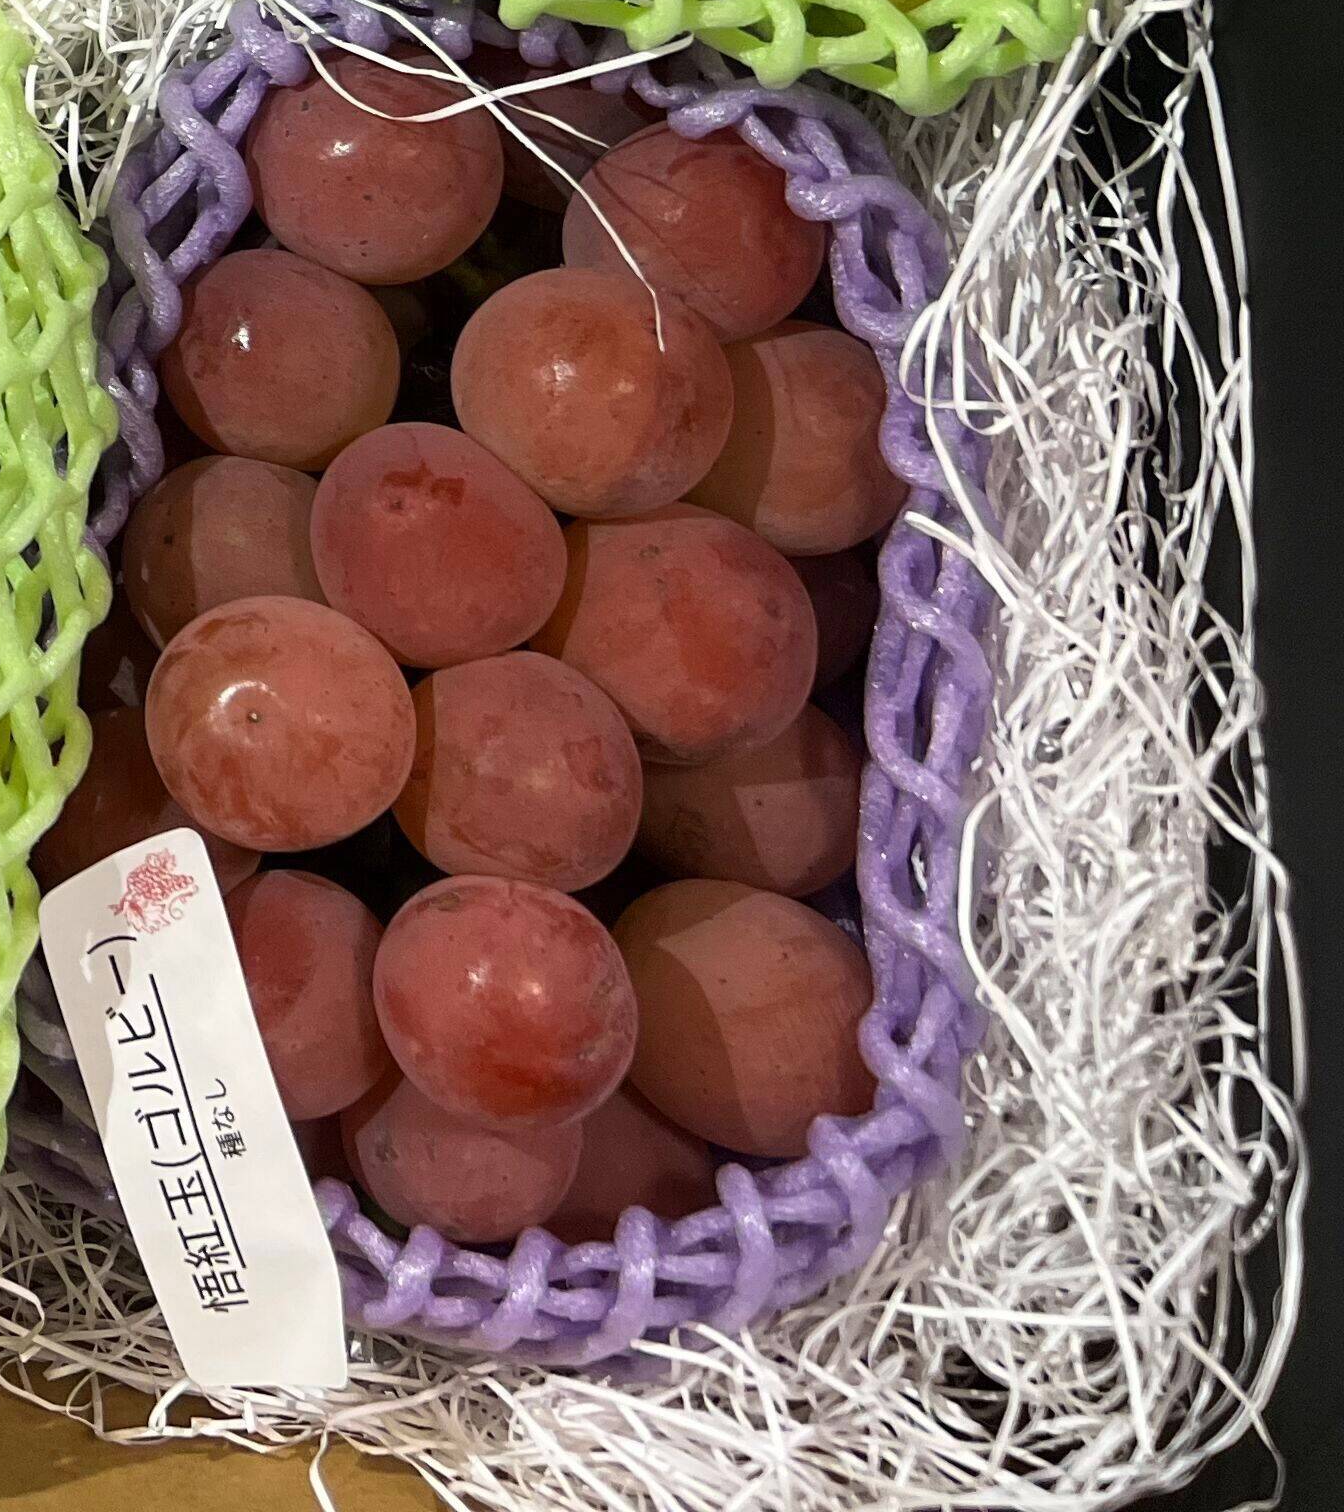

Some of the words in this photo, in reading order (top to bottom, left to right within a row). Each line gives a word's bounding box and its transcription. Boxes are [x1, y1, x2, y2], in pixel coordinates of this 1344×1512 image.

[86, 935, 250, 1314] 悟紅玉(ゴルビー)
[205, 1077, 249, 1160] 種なし
